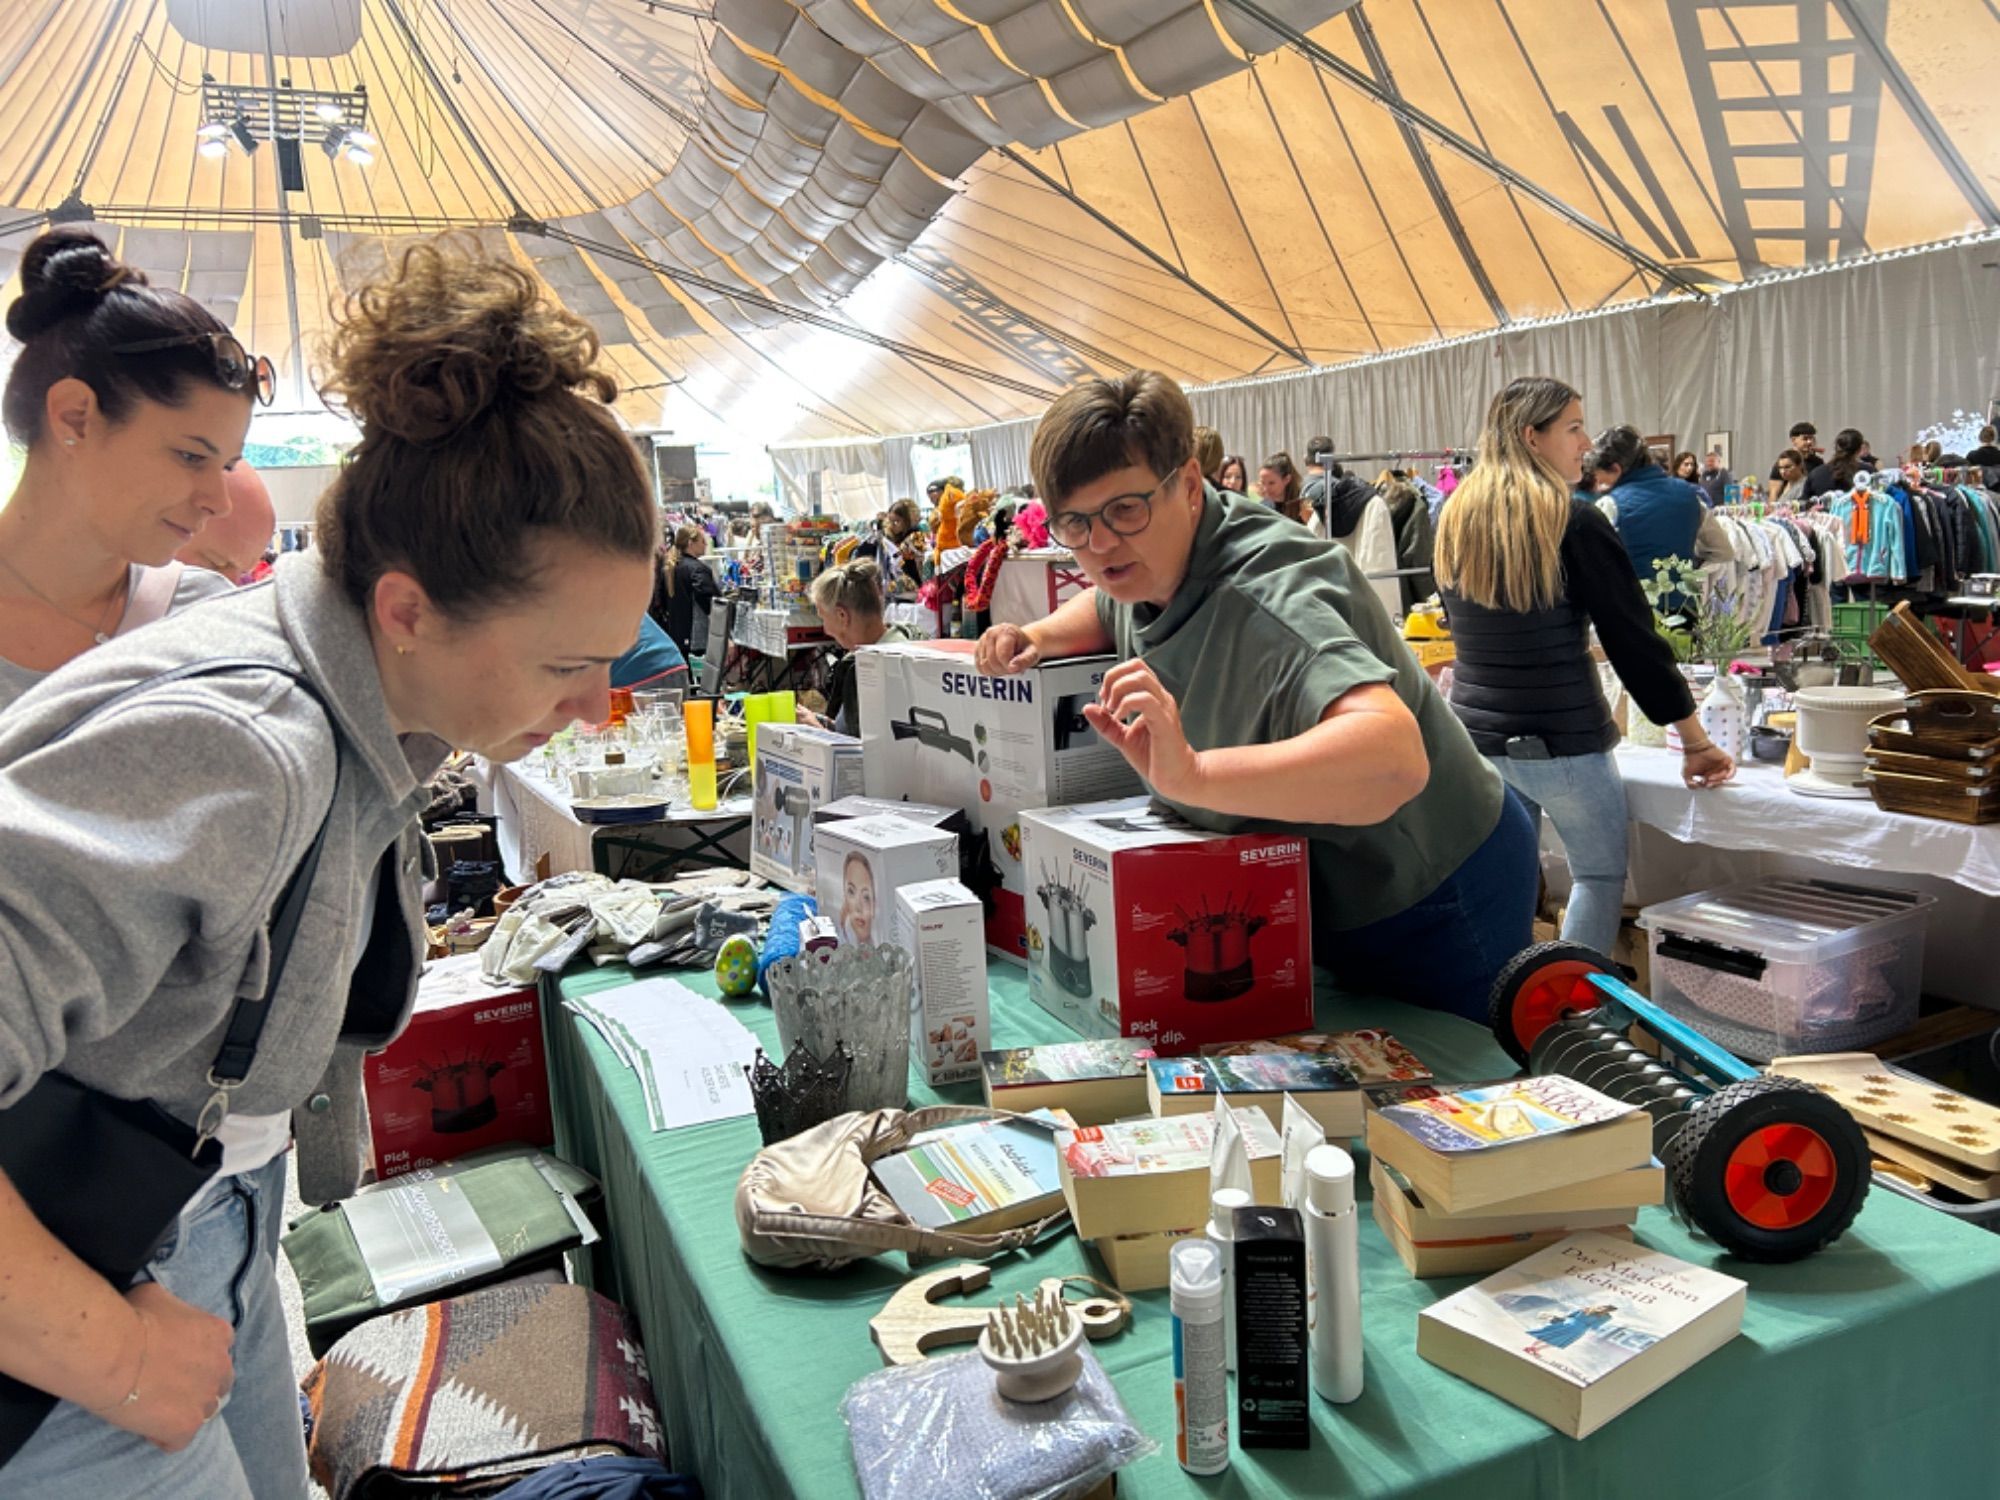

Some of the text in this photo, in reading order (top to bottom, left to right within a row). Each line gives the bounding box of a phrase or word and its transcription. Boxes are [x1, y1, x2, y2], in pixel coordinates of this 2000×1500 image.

[942, 671, 1033, 704] SEVERIN
[1072, 847, 1108, 872] SEVERIN
[1240, 842, 1301, 863] SEVERIN
[473, 1001, 533, 1022] SEVERIN
[1130, 1020, 1159, 1035] Pick
[383, 1150, 411, 1164] Pick
[386, 1163, 411, 1176] and
[1561, 1246, 1598, 1266] Das
[1605, 1260, 1700, 1304] Mädchen
[1564, 1264, 1658, 1306] Edelweiß
